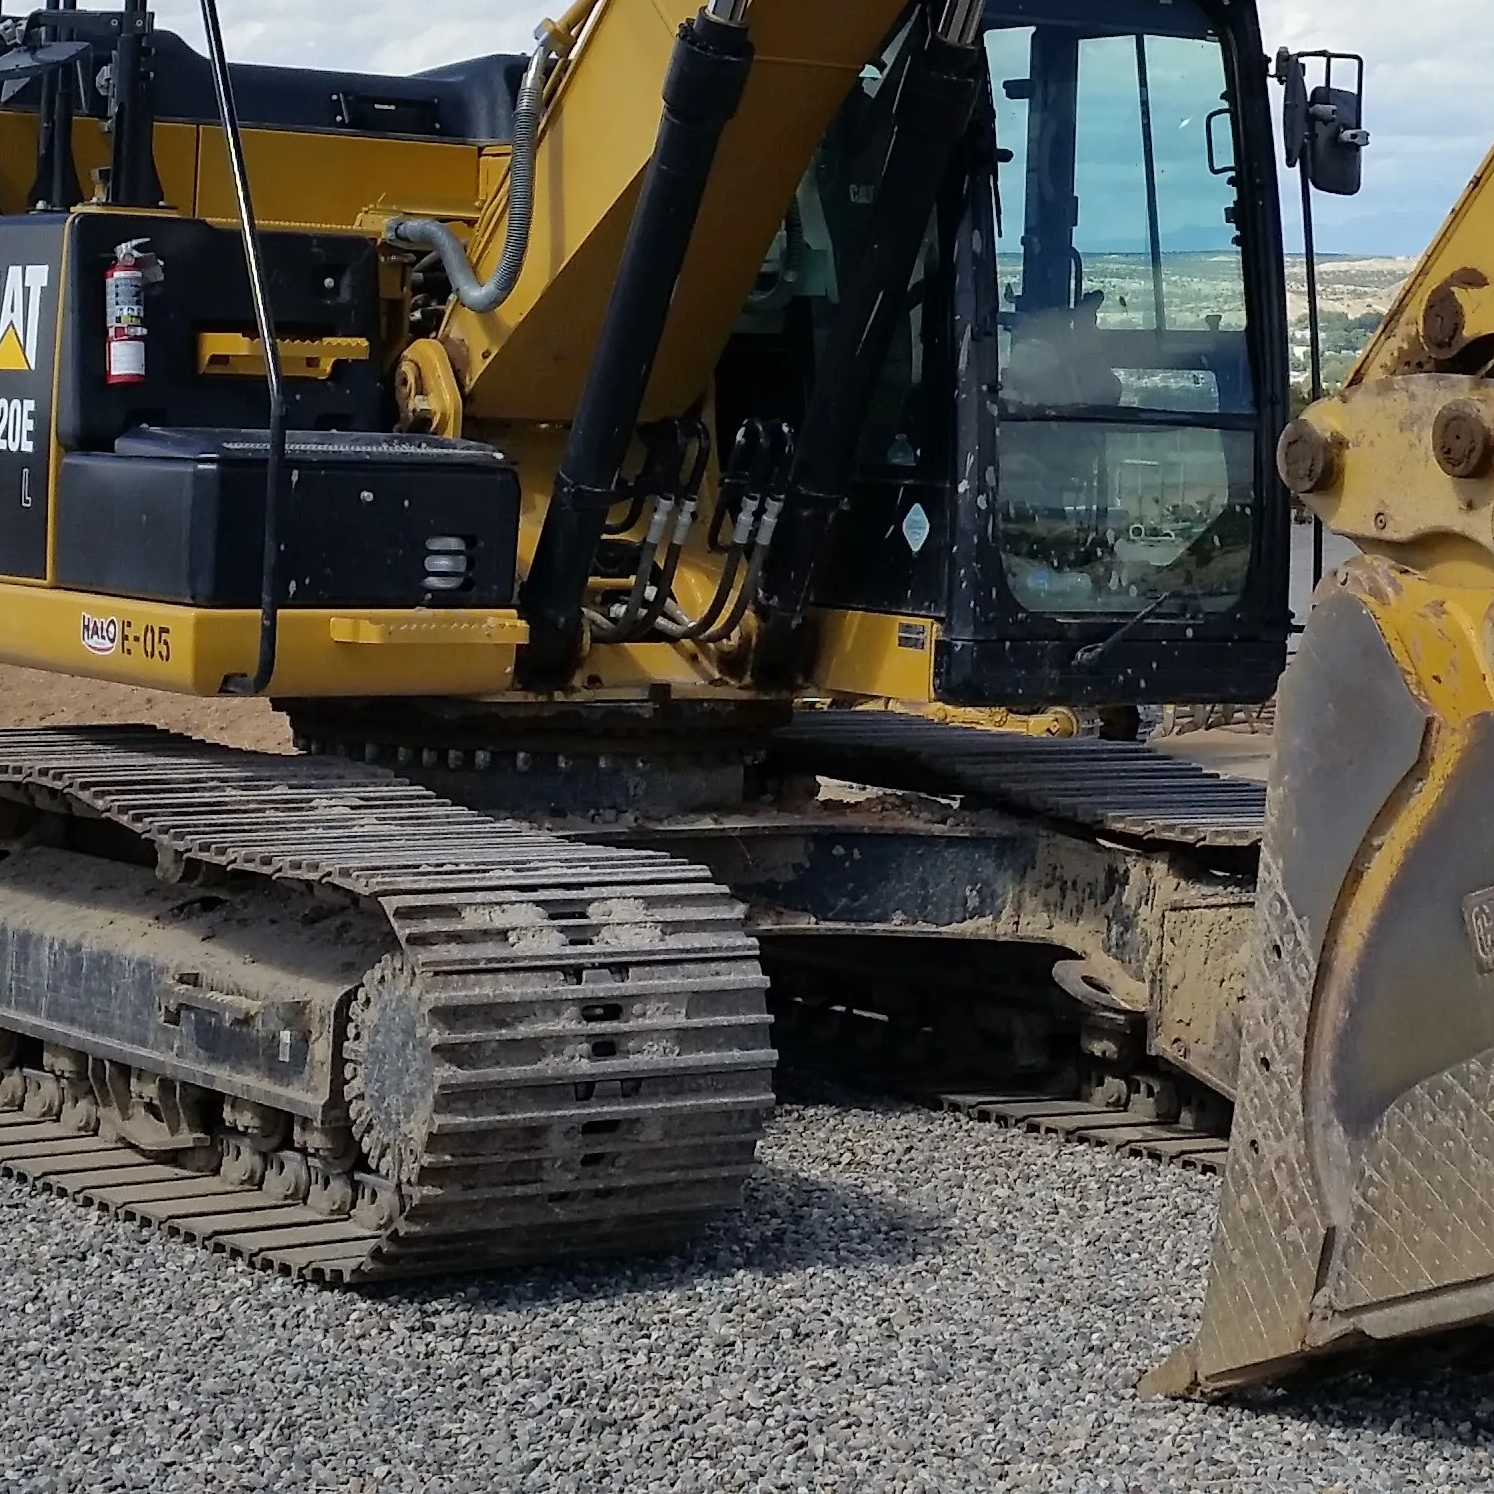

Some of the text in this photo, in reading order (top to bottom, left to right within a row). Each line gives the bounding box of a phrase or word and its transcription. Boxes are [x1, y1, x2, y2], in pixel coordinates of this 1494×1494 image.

[21, 467, 32, 508] L
[82, 614, 117, 644] HALO
[121, 619, 171, 662] E-05
